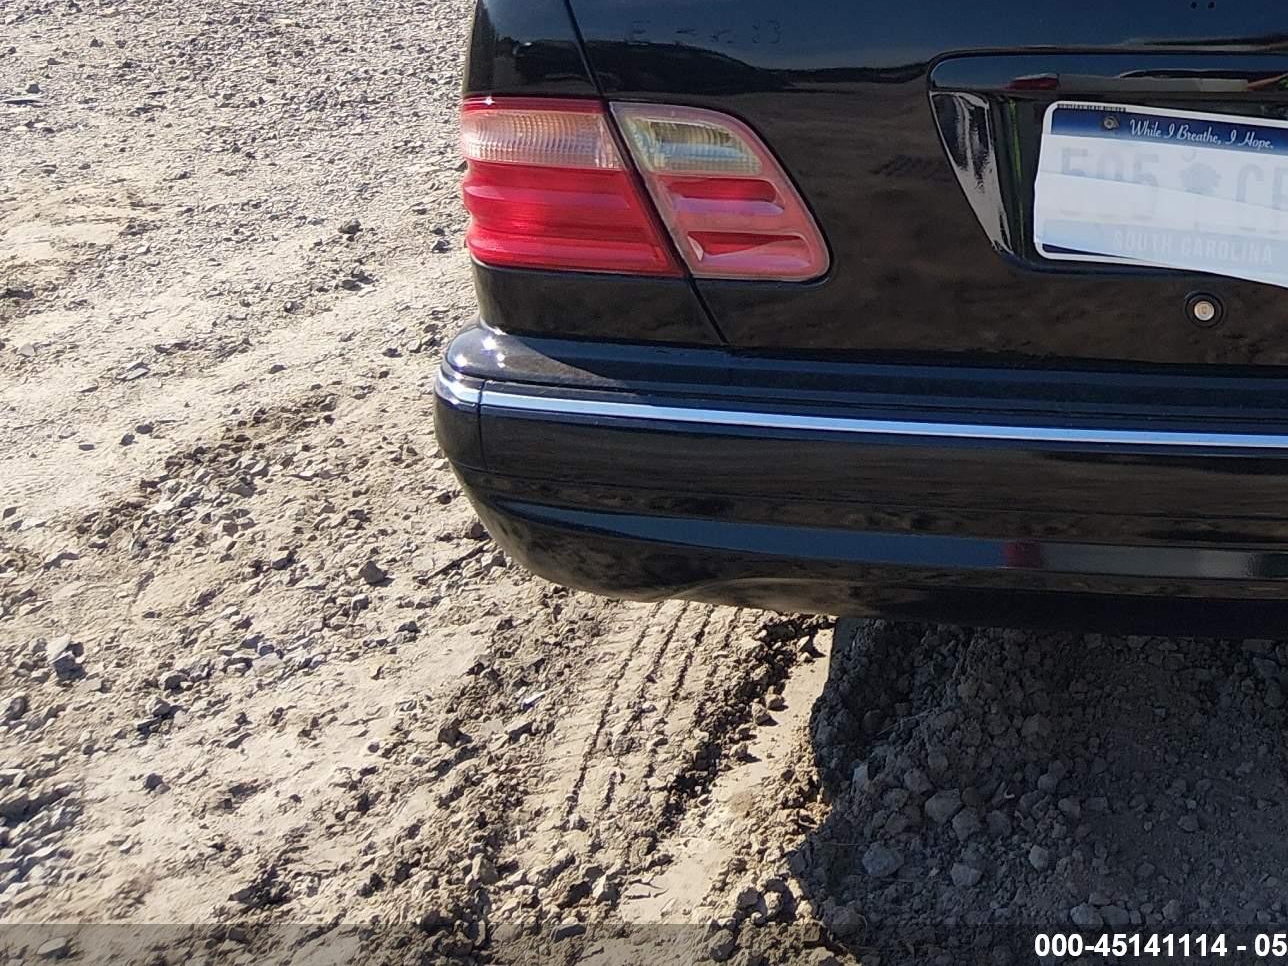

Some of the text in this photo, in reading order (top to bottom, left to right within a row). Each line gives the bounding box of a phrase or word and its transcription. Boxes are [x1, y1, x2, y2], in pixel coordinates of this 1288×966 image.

[1129, 119, 1274, 150] While I Breathe, I Hope.
